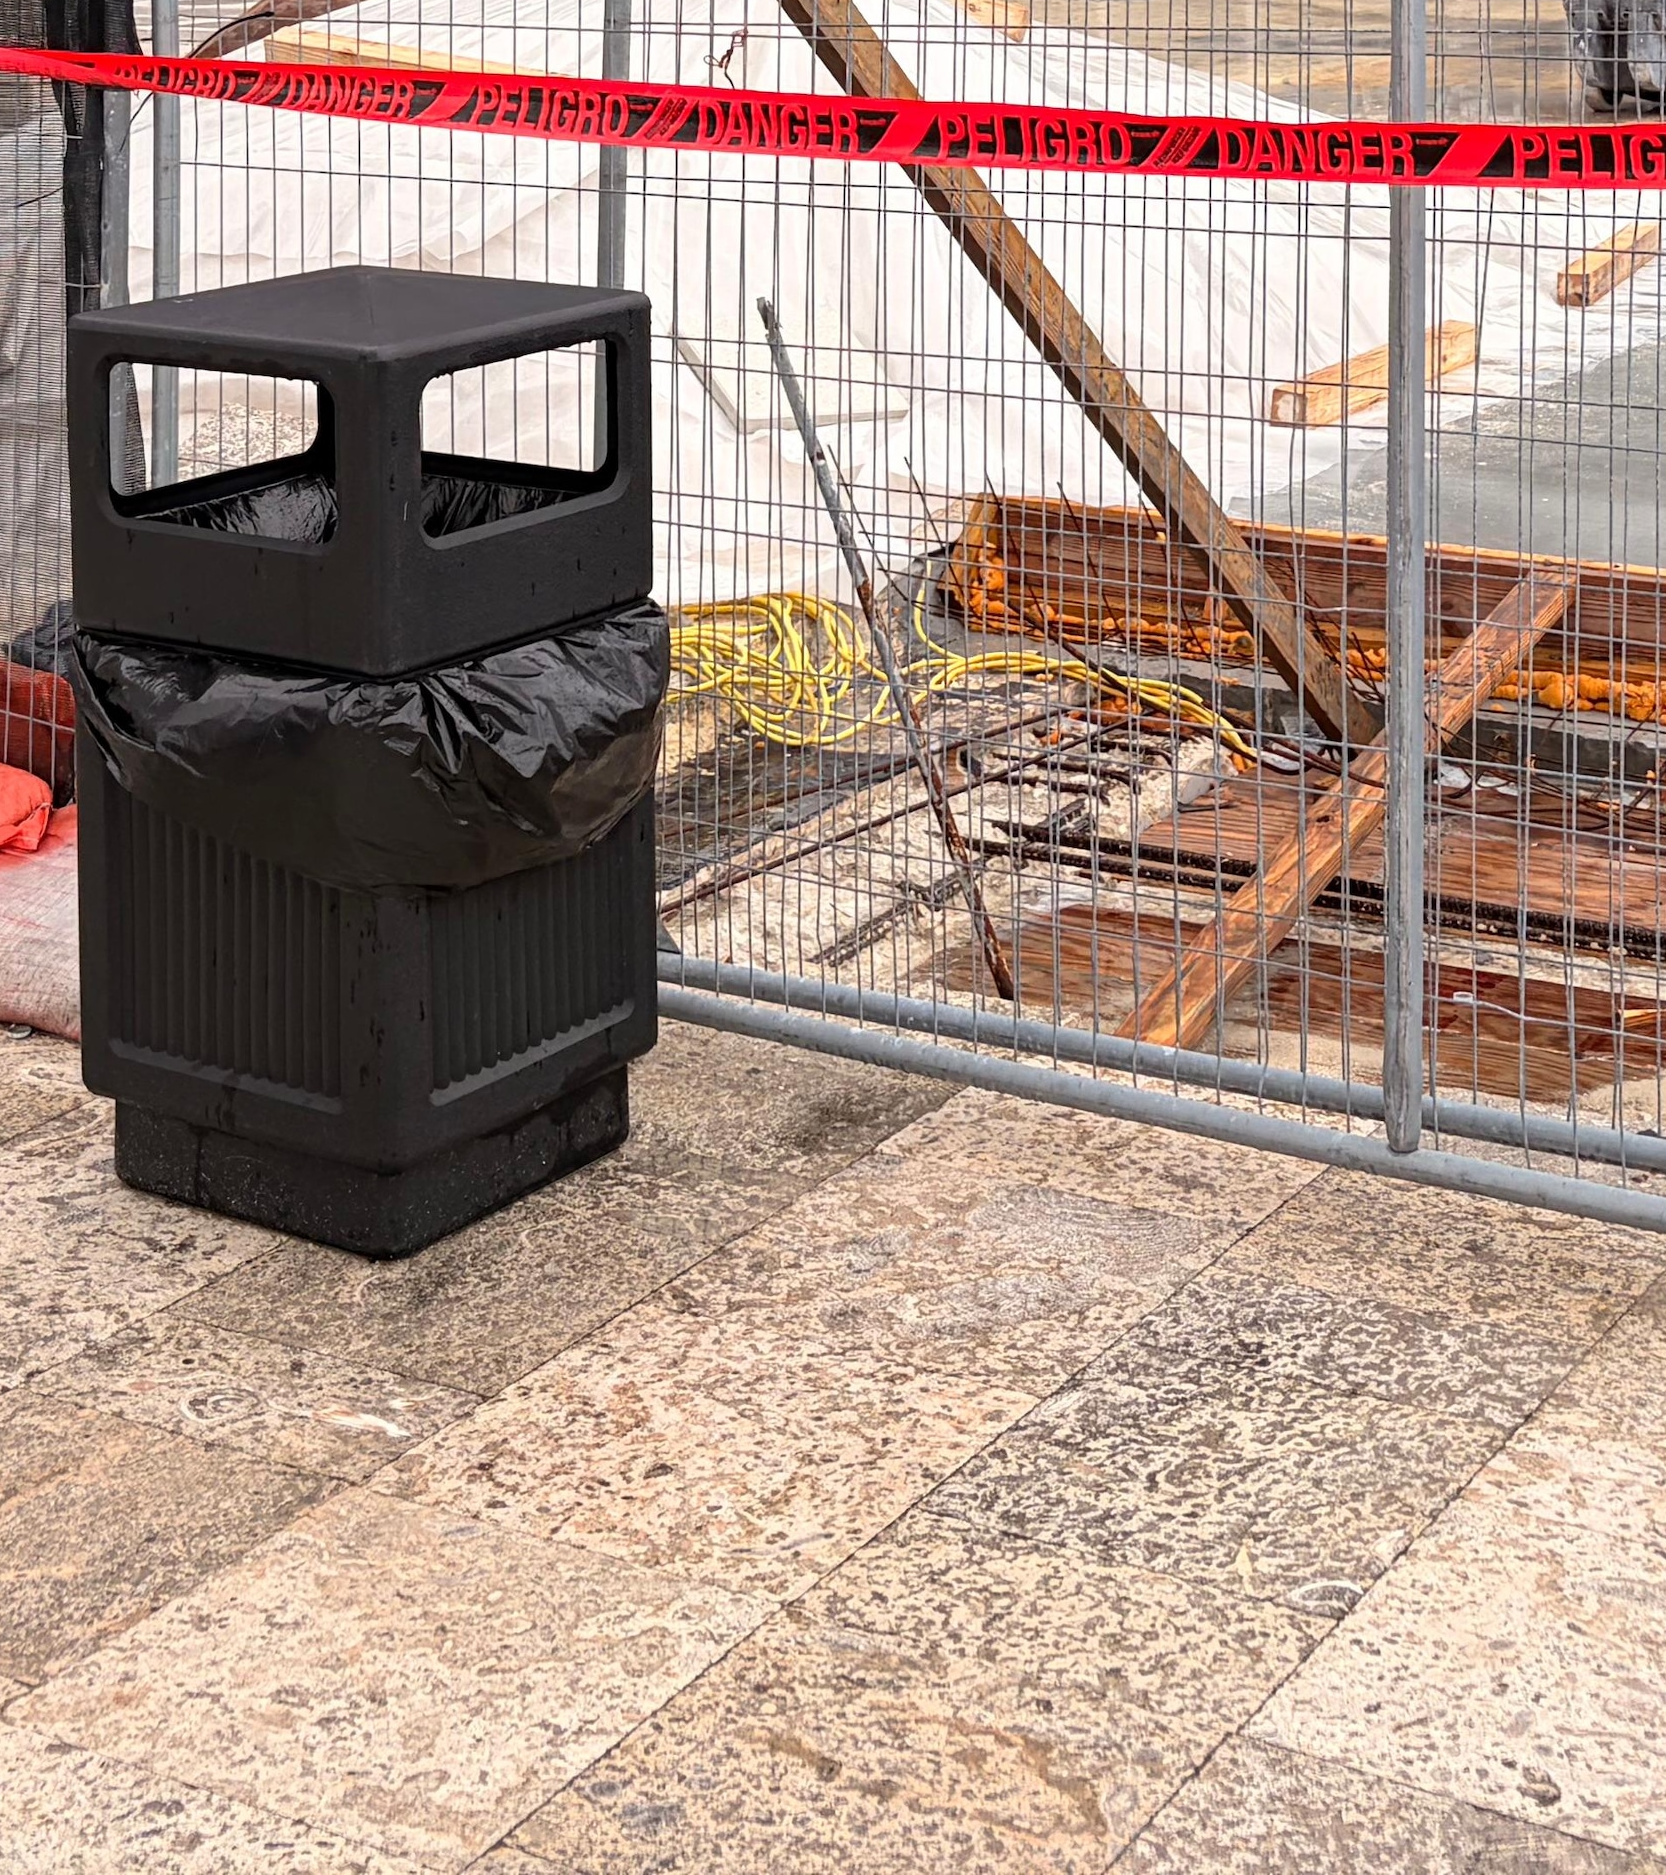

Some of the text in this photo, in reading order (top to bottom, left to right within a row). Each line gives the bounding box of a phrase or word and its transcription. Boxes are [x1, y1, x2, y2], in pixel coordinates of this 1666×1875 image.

[285, 73, 416, 121] DANGER
[471, 83, 631, 138] PELIGRO
[697, 99, 858, 156] DANGER
[937, 112, 1132, 166] PELIGRO
[1217, 129, 1417, 178] DANGER
